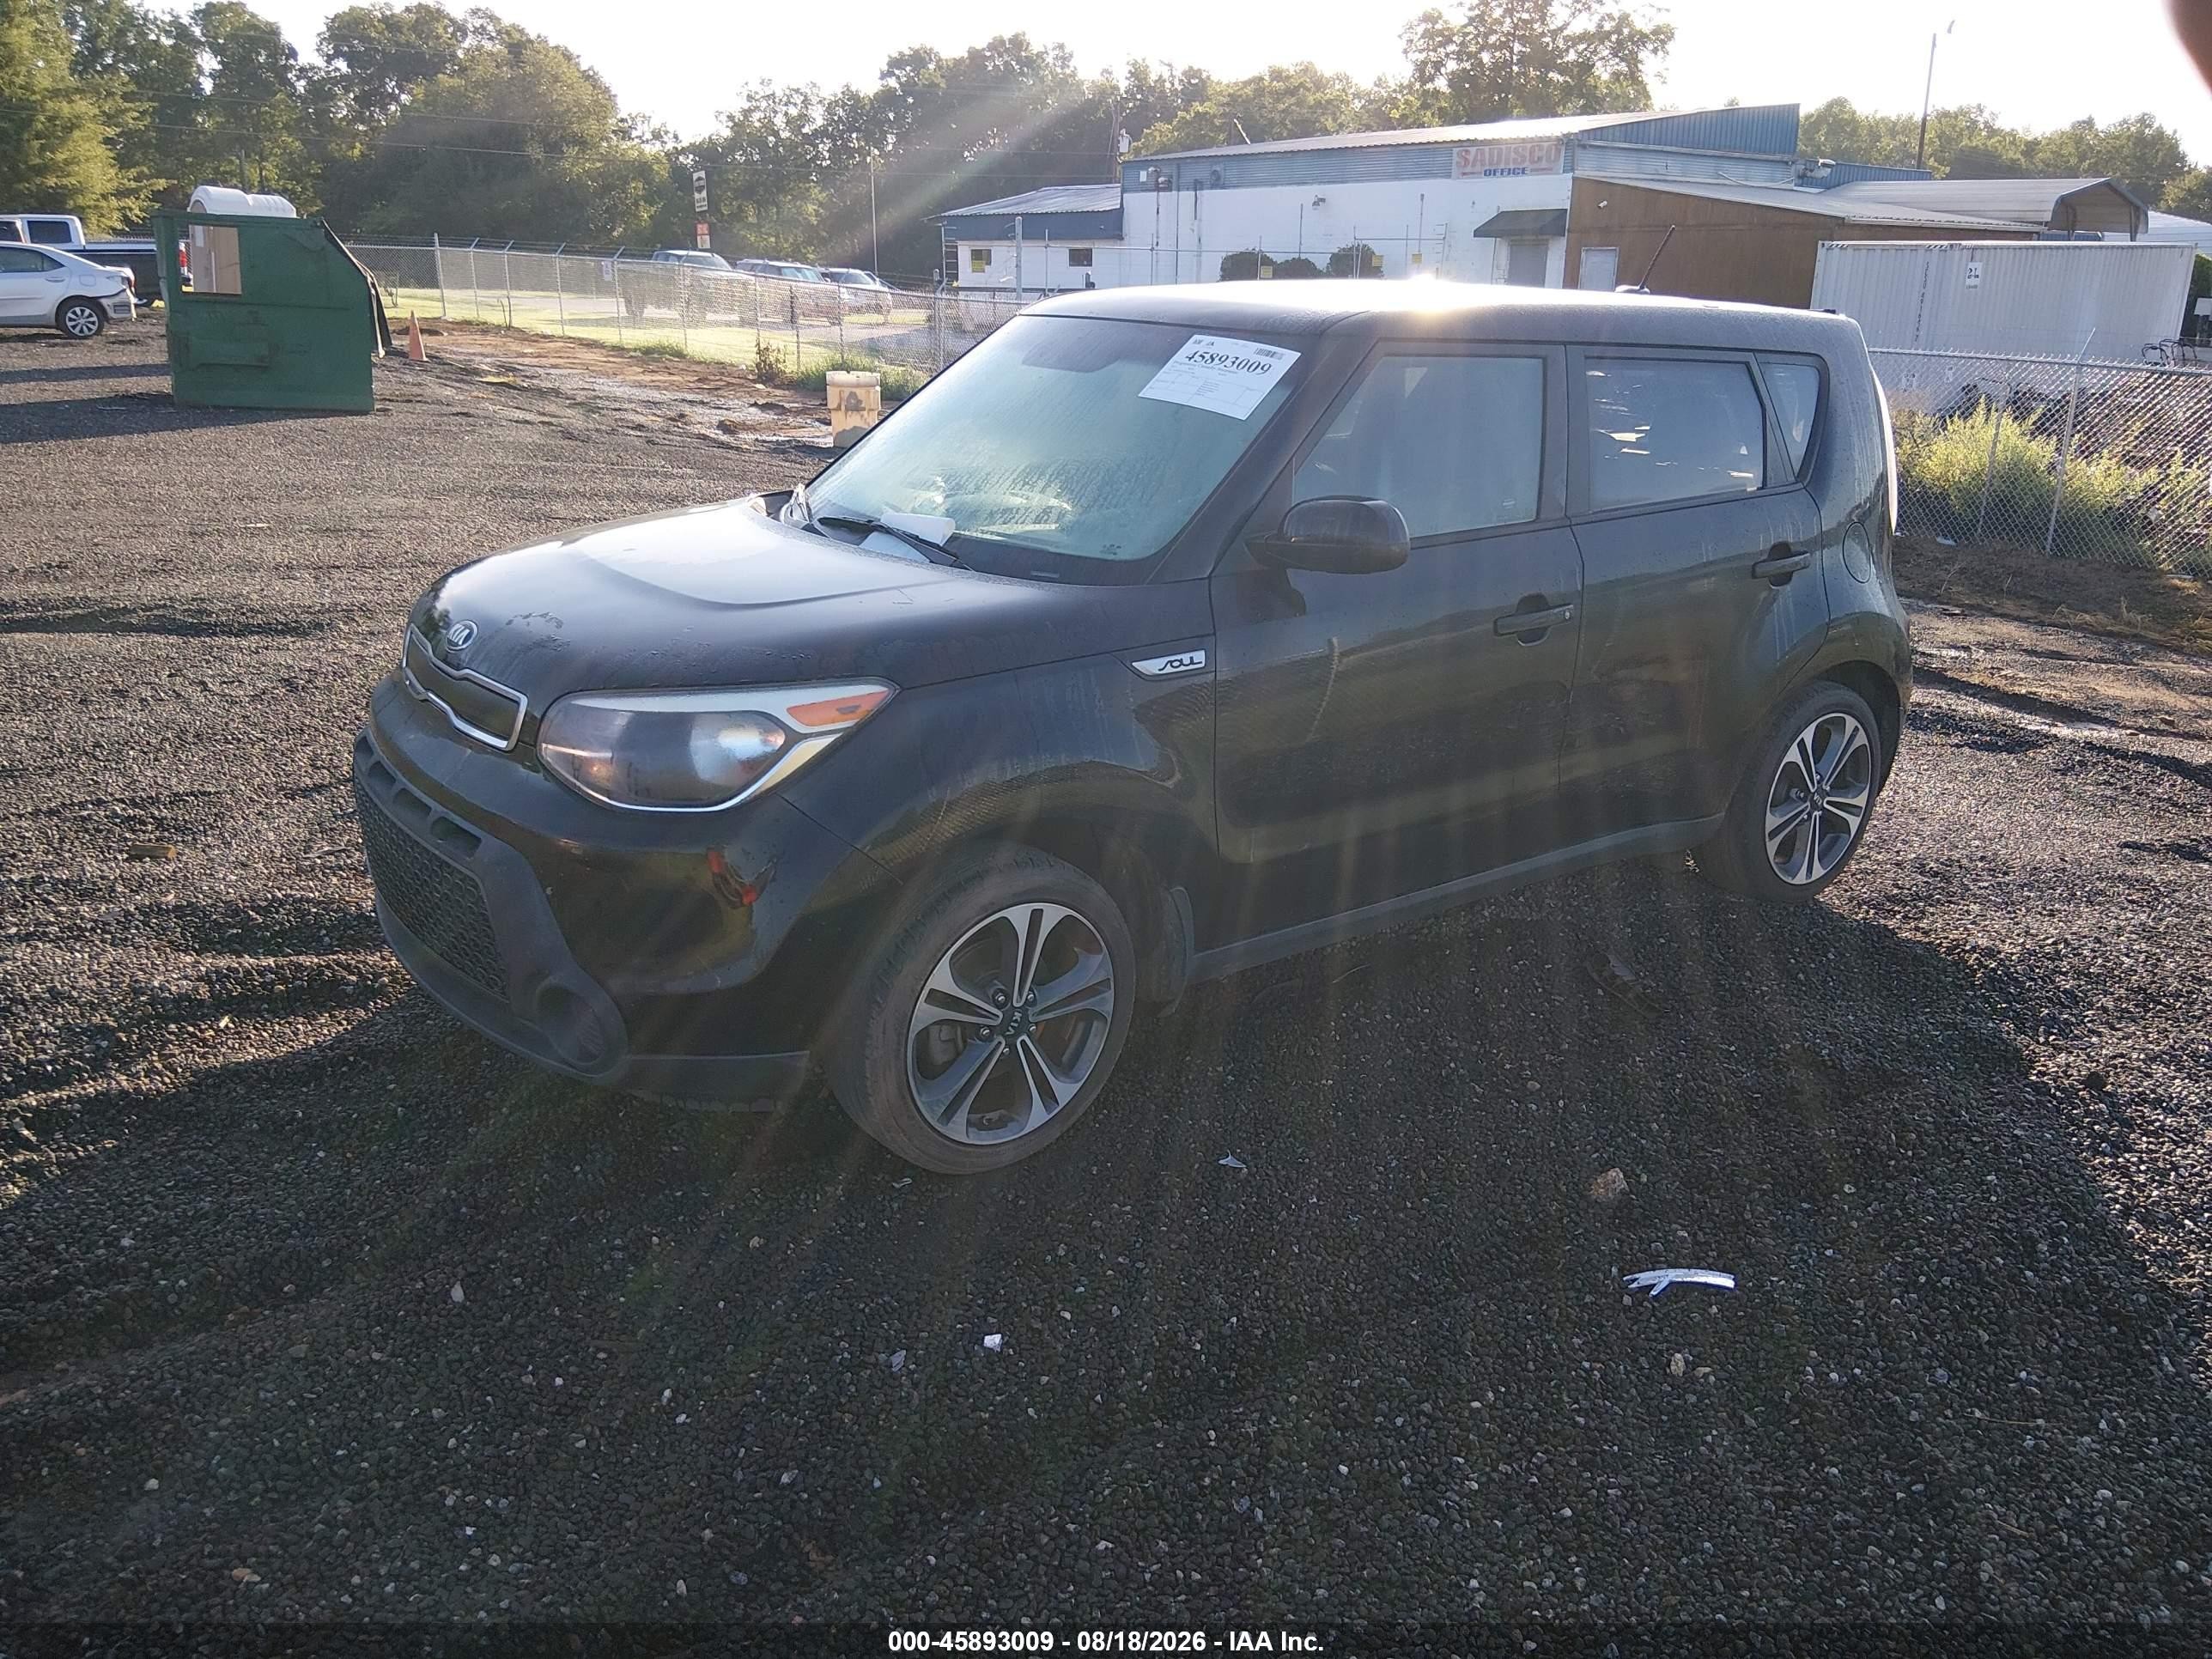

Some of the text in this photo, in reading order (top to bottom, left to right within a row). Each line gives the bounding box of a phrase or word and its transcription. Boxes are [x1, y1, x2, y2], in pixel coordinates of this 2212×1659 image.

[1455, 143, 1561, 168] SADISCO
[1483, 167, 1529, 177] OFFICE
[1185, 349, 1273, 375] 45893009
[1005, 1011, 1023, 1035] KIA
